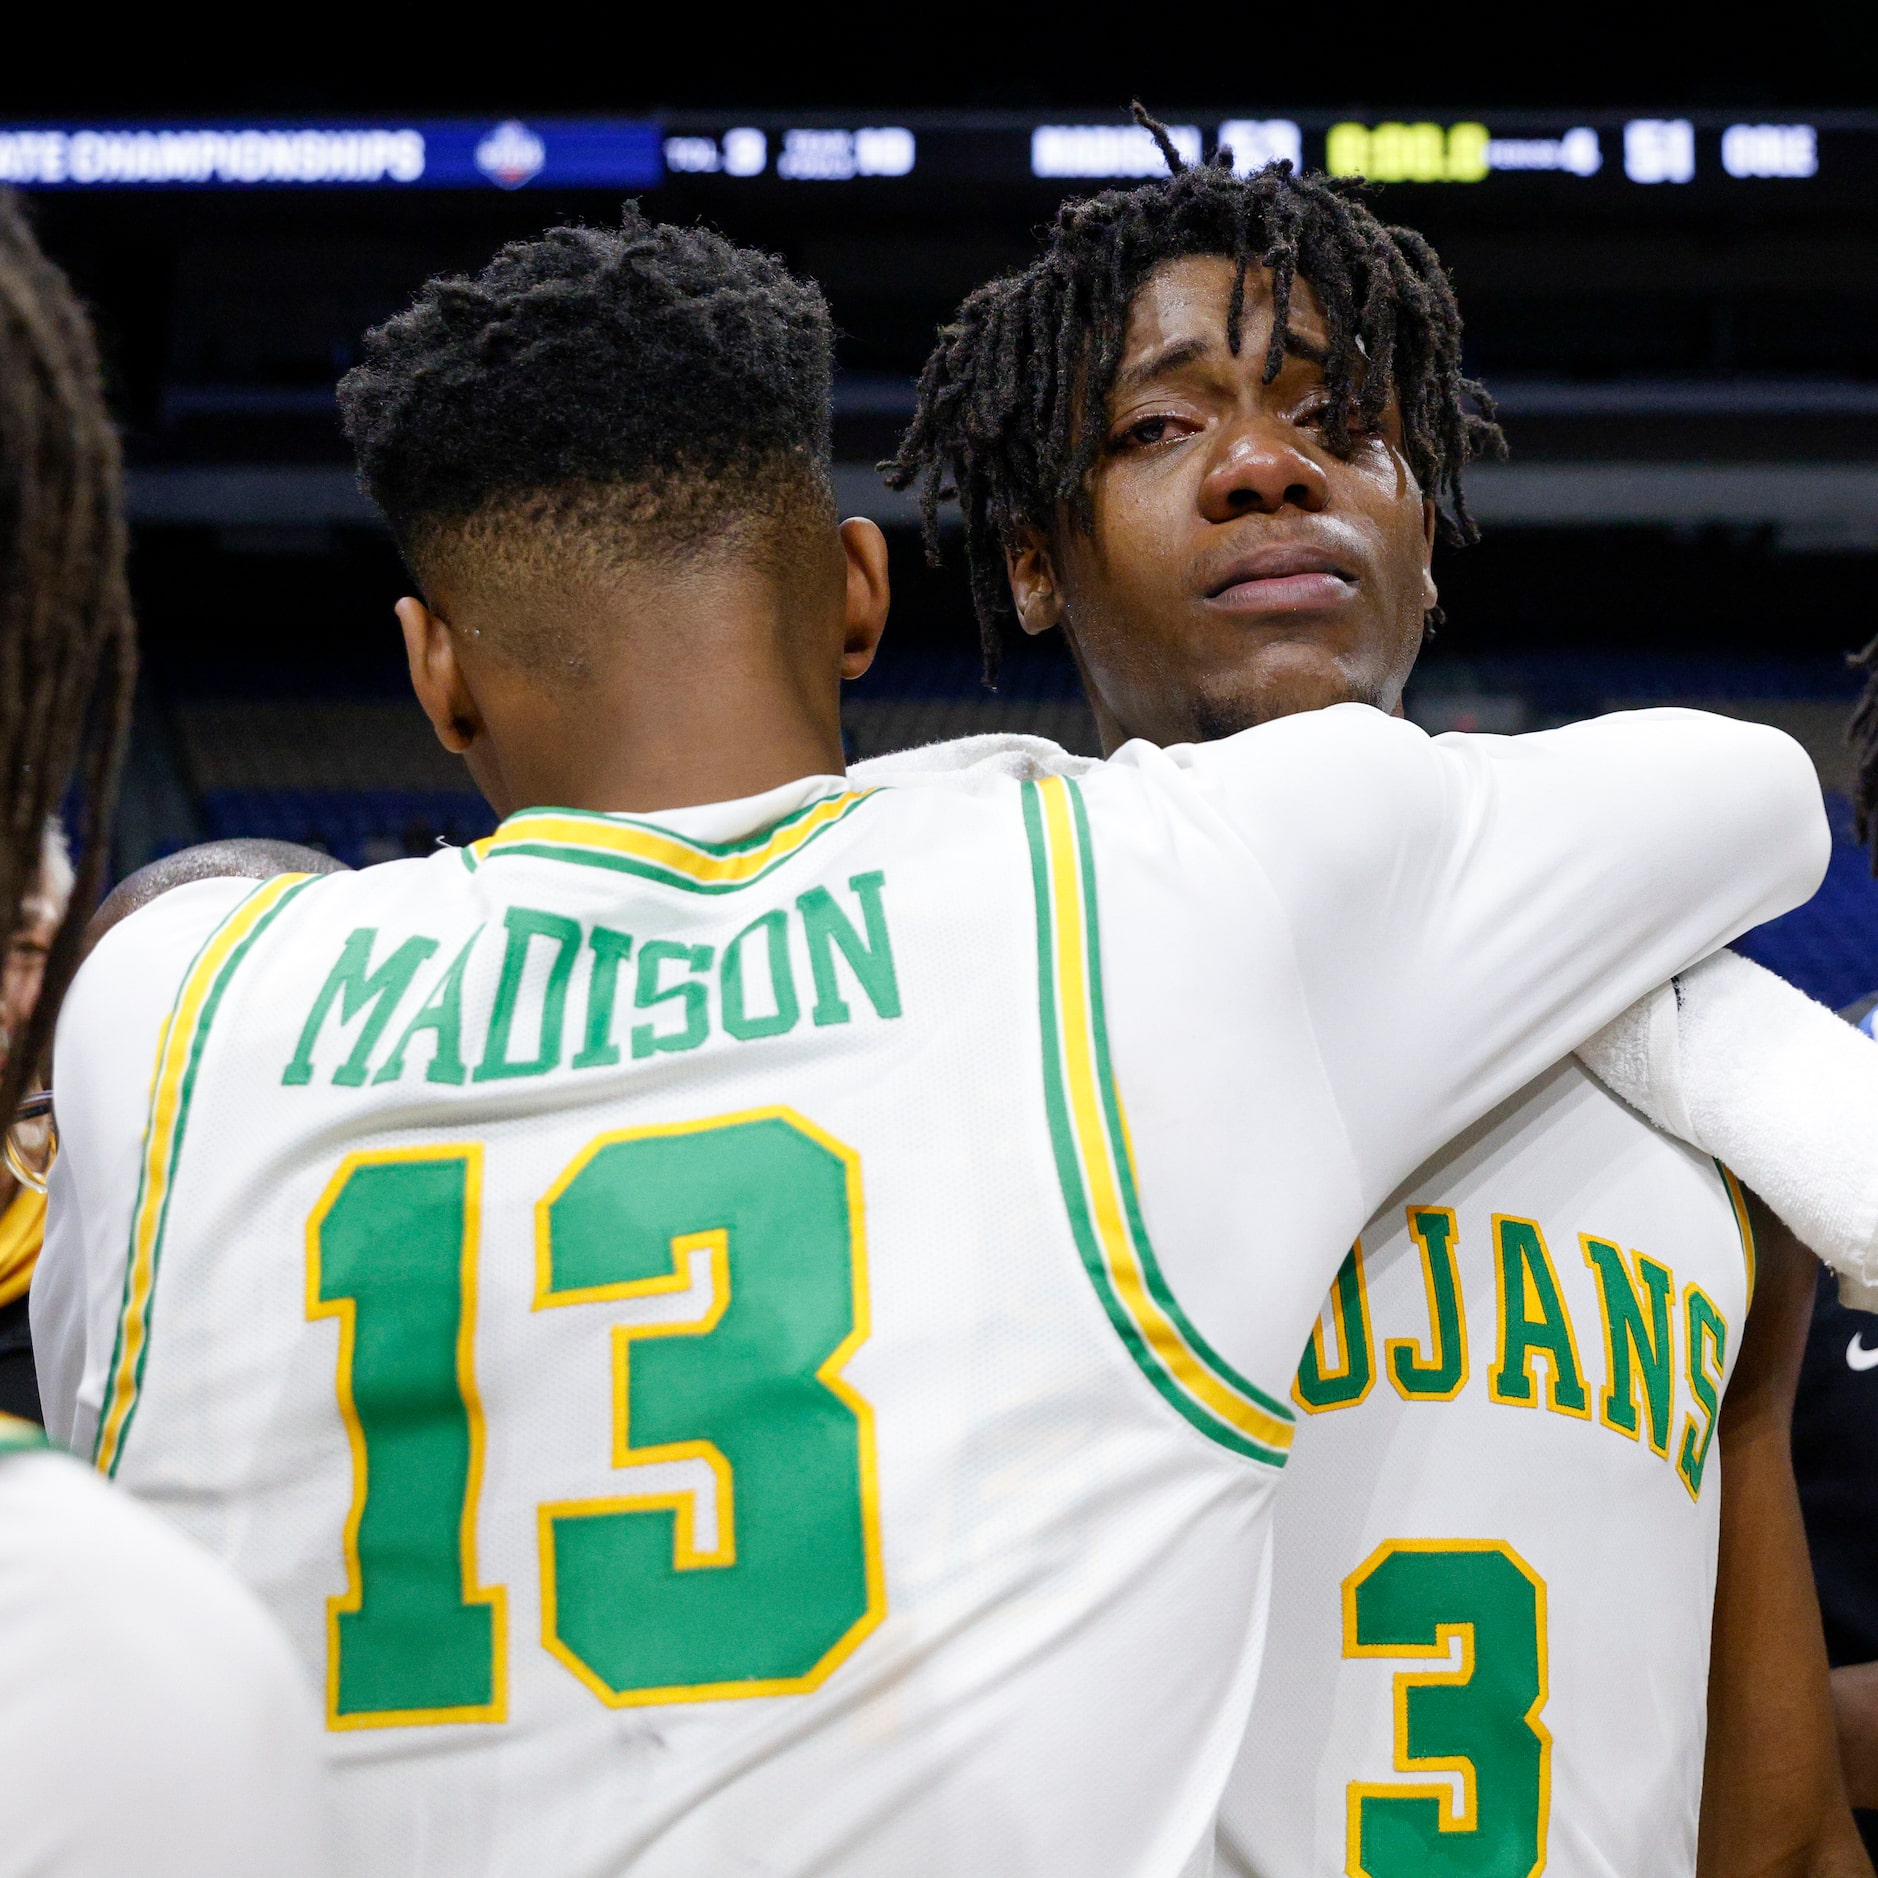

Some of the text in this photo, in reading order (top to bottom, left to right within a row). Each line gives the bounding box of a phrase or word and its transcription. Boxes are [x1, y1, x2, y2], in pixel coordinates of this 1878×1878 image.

[70, 130, 425, 182] CHAMPIONSHIPS
[282, 871, 901, 1087] MADISON
[304, 1104, 889, 1733] 13
[1341, 1538, 1553, 1878] 3
